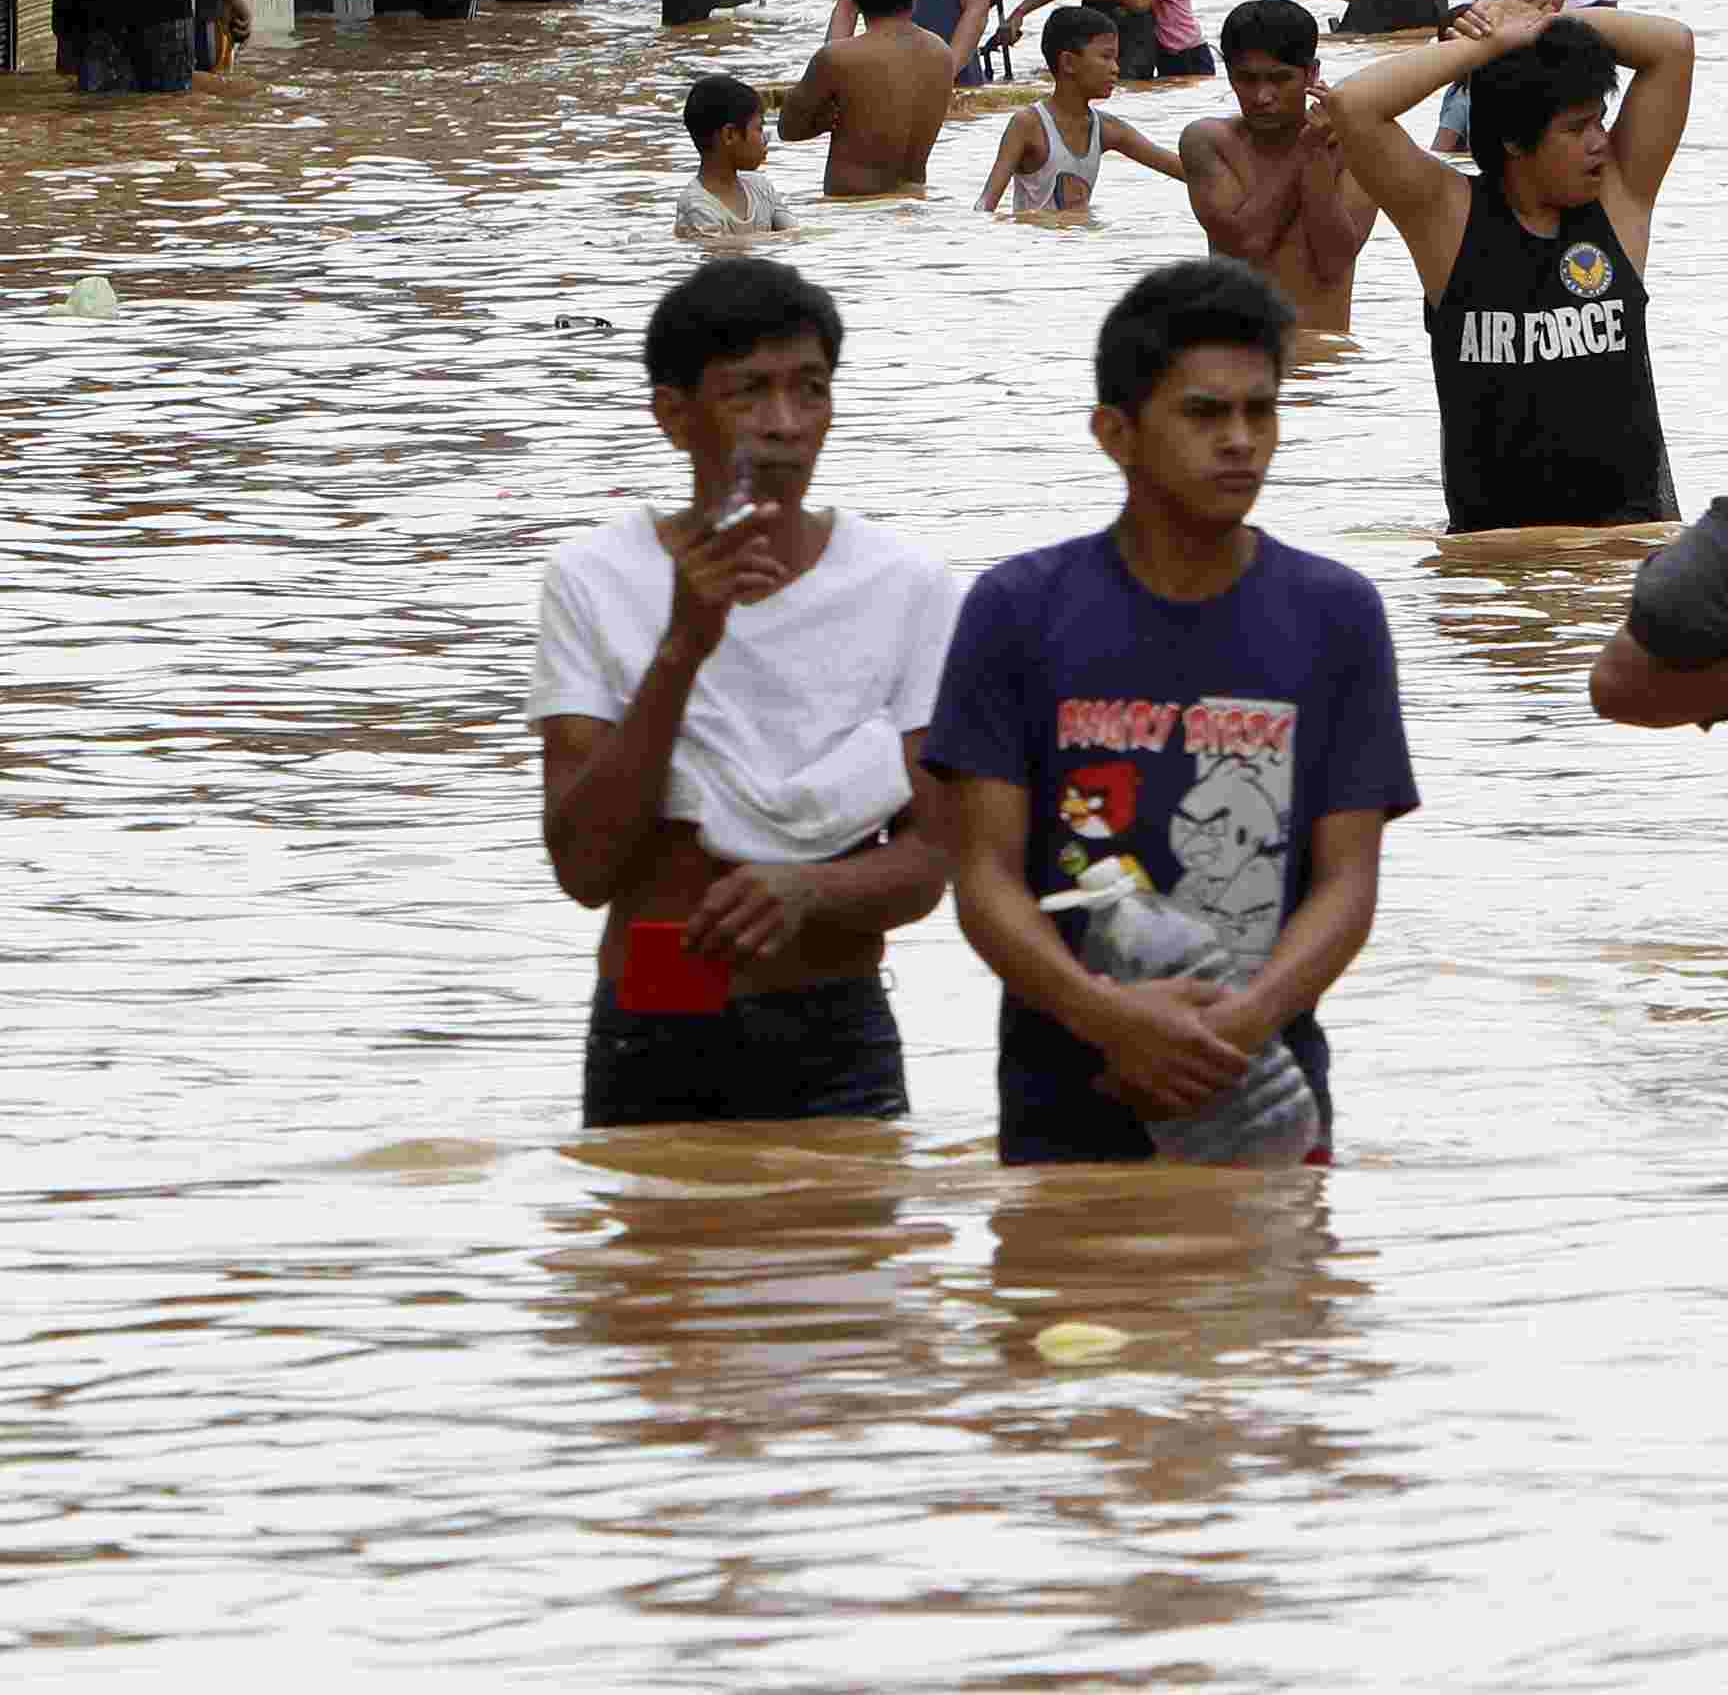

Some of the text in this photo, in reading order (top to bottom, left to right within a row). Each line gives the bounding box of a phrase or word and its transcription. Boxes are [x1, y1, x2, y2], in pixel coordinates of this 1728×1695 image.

[1459, 298, 1628, 365] AIR FORCE
[1055, 698, 1182, 753] ANGRY
